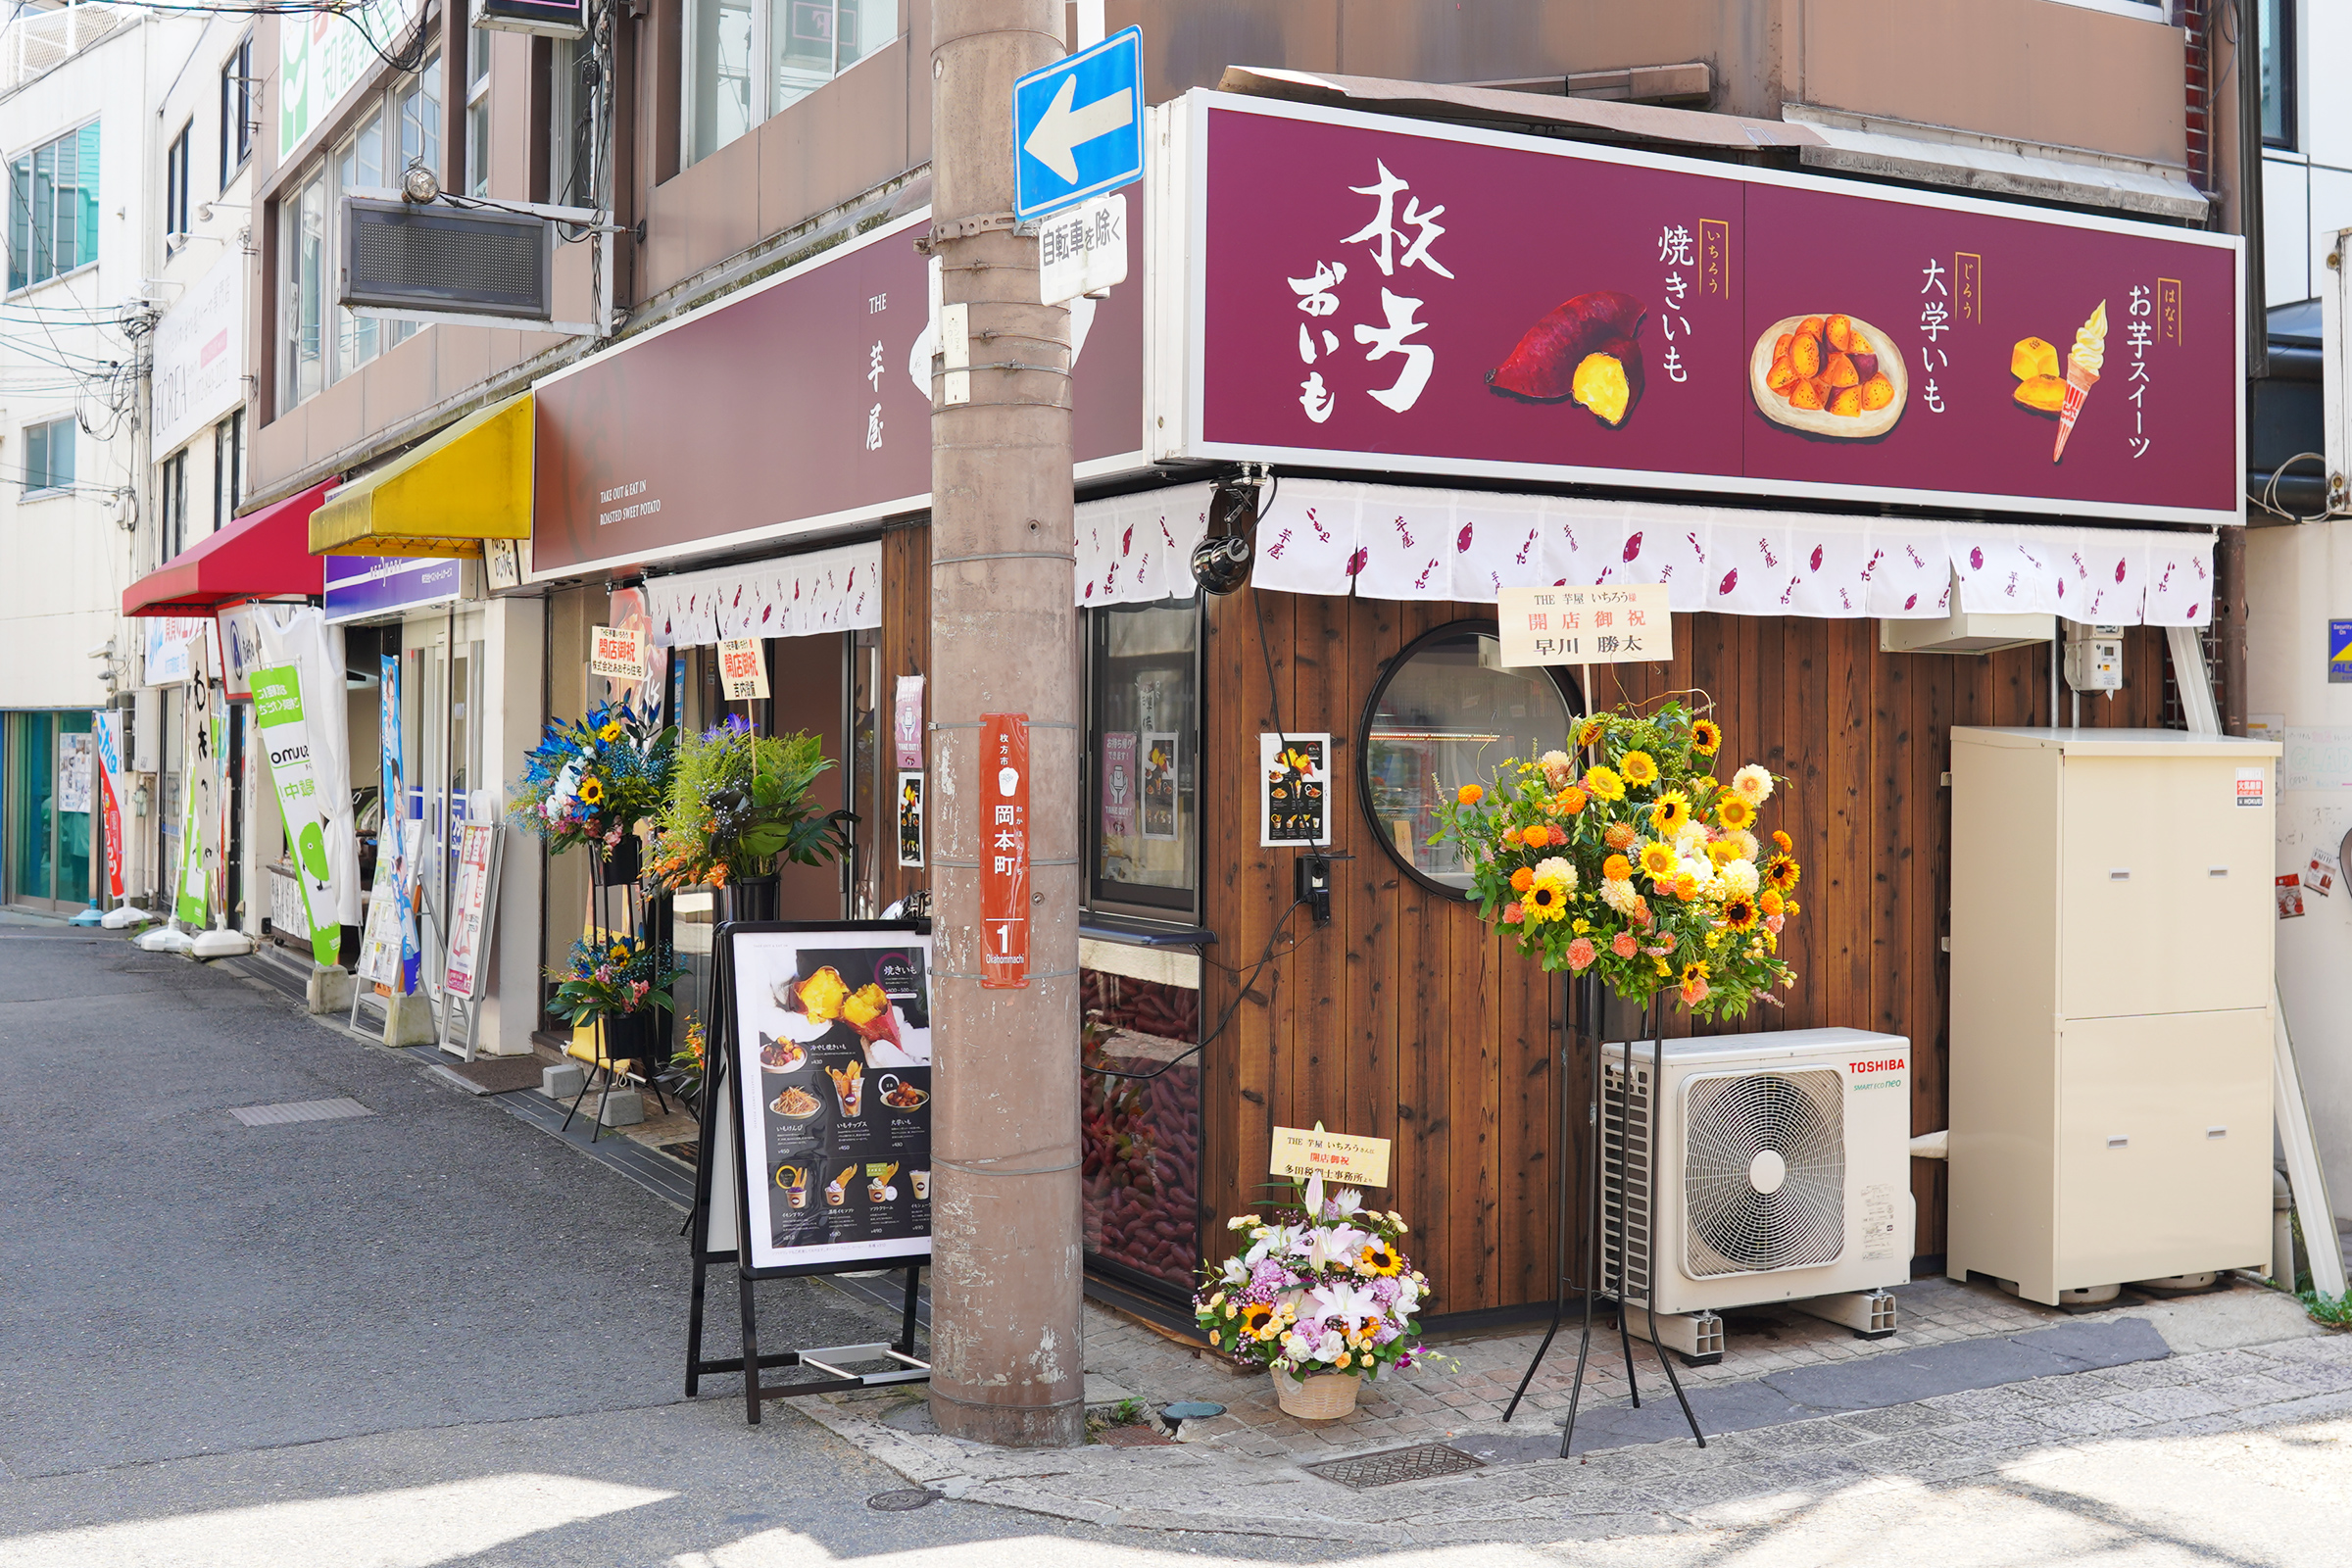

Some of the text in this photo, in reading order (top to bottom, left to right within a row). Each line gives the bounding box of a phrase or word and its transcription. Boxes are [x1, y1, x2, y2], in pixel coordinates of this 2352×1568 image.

[1043, 208, 1121, 267] 自転車を除く
[1706, 228, 1722, 294] いちろう
[868, 293, 887, 314] THE
[1658, 224, 1695, 382] 焼きいも
[1961, 263, 1976, 318] じろう
[2164, 289, 2176, 338] はなこ
[1288, 260, 1348, 423] おいも
[1919, 258, 1950, 415] 大学いも
[2126, 284, 2153, 460] お芋スイーツ
[866, 340, 885, 451] 芋屋
[600, 479, 647, 504] TAKE OUT & EAT IN
[600, 499, 661, 526] ROASTED SWEET POTATO
[1267, 528, 1293, 560] 芋屋
[1395, 515, 1414, 549] 芋屋
[1759, 538, 1778, 569] 芋屋
[1535, 594, 1555, 606] THE
[1563, 593, 1585, 605] 芋屋
[598, 638, 636, 663] 開店御祝
[1534, 635, 1643, 656] 早川 勝太
[592, 661, 643, 677] 株式会社あおぞら住宅
[724, 651, 759, 678] 開店御祝
[1000, 733, 1009, 765] 枚方市
[1106, 737, 1133, 749] お持ち帰り
[1105, 806, 1117, 815] TAKE
[994, 805, 1015, 876] 岡本町
[997, 924, 1008, 954] 1
[884, 964, 917, 976] 焼きいも
[1849, 1058, 1905, 1074] TOSHIBA
[1853, 1083, 1873, 1092] SMART
[1886, 1079, 1901, 1088] neo
[1287, 1137, 1303, 1146] THE
[1307, 1139, 1323, 1149] 芋屋
[1309, 1152, 1349, 1165] 開店御祝
